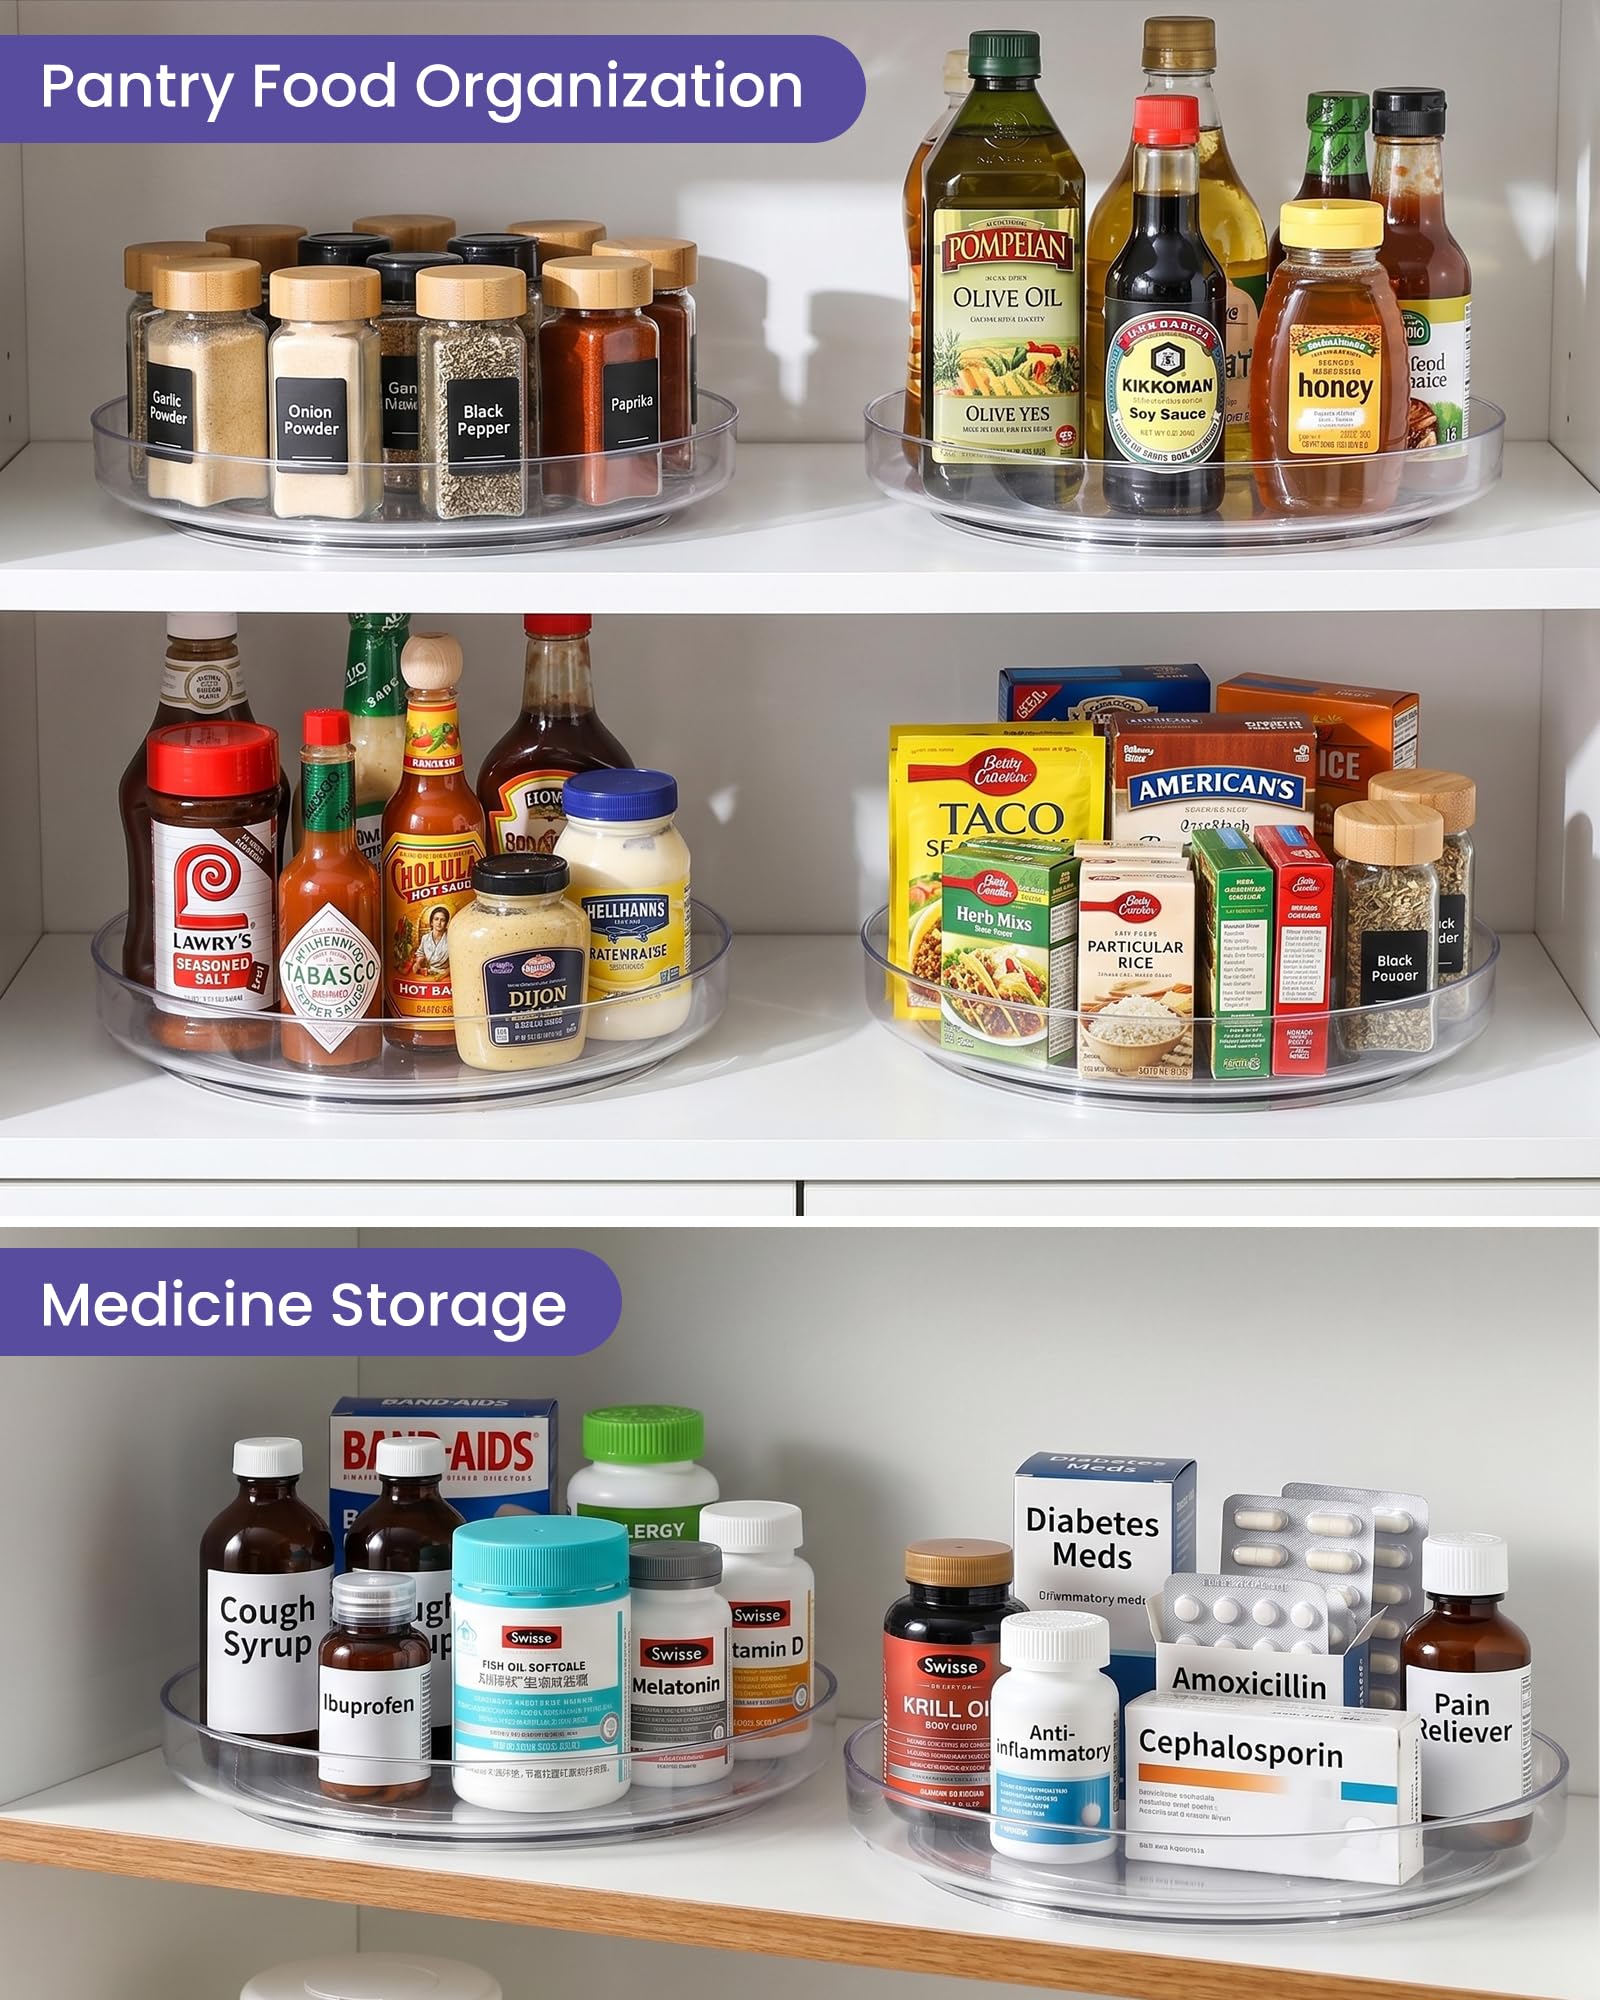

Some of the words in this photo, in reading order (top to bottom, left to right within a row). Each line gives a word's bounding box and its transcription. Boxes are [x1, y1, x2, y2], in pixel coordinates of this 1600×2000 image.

[949, 231, 1066, 263] POMPEIAN
[953, 286, 1019, 308] OLIVE
[1025, 286, 1063, 308] OIL
[1122, 378, 1213, 395] KIKKOMAN
[1298, 371, 1374, 405] honey
[152, 390, 182, 408] Garlic
[611, 394, 653, 413] Paprika
[150, 405, 188, 425] Powder
[288, 404, 332, 419] Onion
[463, 403, 504, 420] Black
[965, 405, 1016, 422] OLIVE
[1019, 405, 1051, 422] YES
[1129, 407, 1156, 422] Soy
[1160, 408, 1207, 421] Sauce
[284, 420, 340, 436] Powder
[457, 422, 511, 439] Pepper
[1139, 771, 1295, 801] AMERICAN'S
[939, 801, 1065, 836] TACO
[411, 885, 441, 902] HOT
[956, 905, 995, 926] Herb
[997, 912, 1033, 932] Mixs
[173, 931, 252, 951] LAWRY'S
[1088, 940, 1185, 954] PARTICULAR
[175, 956, 250, 973] SEASONED
[1118, 956, 1154, 970] RICE
[1377, 953, 1414, 967] Black
[194, 972, 231, 986] SALT
[285, 960, 376, 986] TABASCO
[400, 984, 427, 996] HOT
[431, 984, 453, 996] BA
[508, 984, 568, 1009] DIJON
[381, 1398, 510, 1407] BAND-AIDS
[343, 1430, 535, 1472] BA-AIDS
[1048, 1456, 1168, 1467] Diabetes
[1066, 1463, 1138, 1473] Meds
[1026, 1506, 1160, 1537] Diabetes
[1053, 1541, 1133, 1570] Meds
[220, 1594, 315, 1631] Cough
[734, 1608, 781, 1622] Swisse
[223, 1629, 312, 1664] Syrup
[511, 1631, 552, 1644] Swisse
[791, 1636, 804, 1656] D
[651, 1646, 702, 1662] Swisse
[482, 1659, 504, 1671] FISH
[924, 1657, 979, 1675] Swisse
[632, 1676, 720, 1696] Melatonin
[1171, 1666, 1327, 1700] Amoxicillin
[323, 1692, 415, 1719] Ibuprofen
[903, 1695, 962, 1719] KRILL
[1434, 1692, 1491, 1716] Pain
[1029, 1724, 1076, 1742] Anti-
[996, 1737, 1111, 1763] inflammatory
[1139, 1728, 1344, 1770] Cephalosporin
